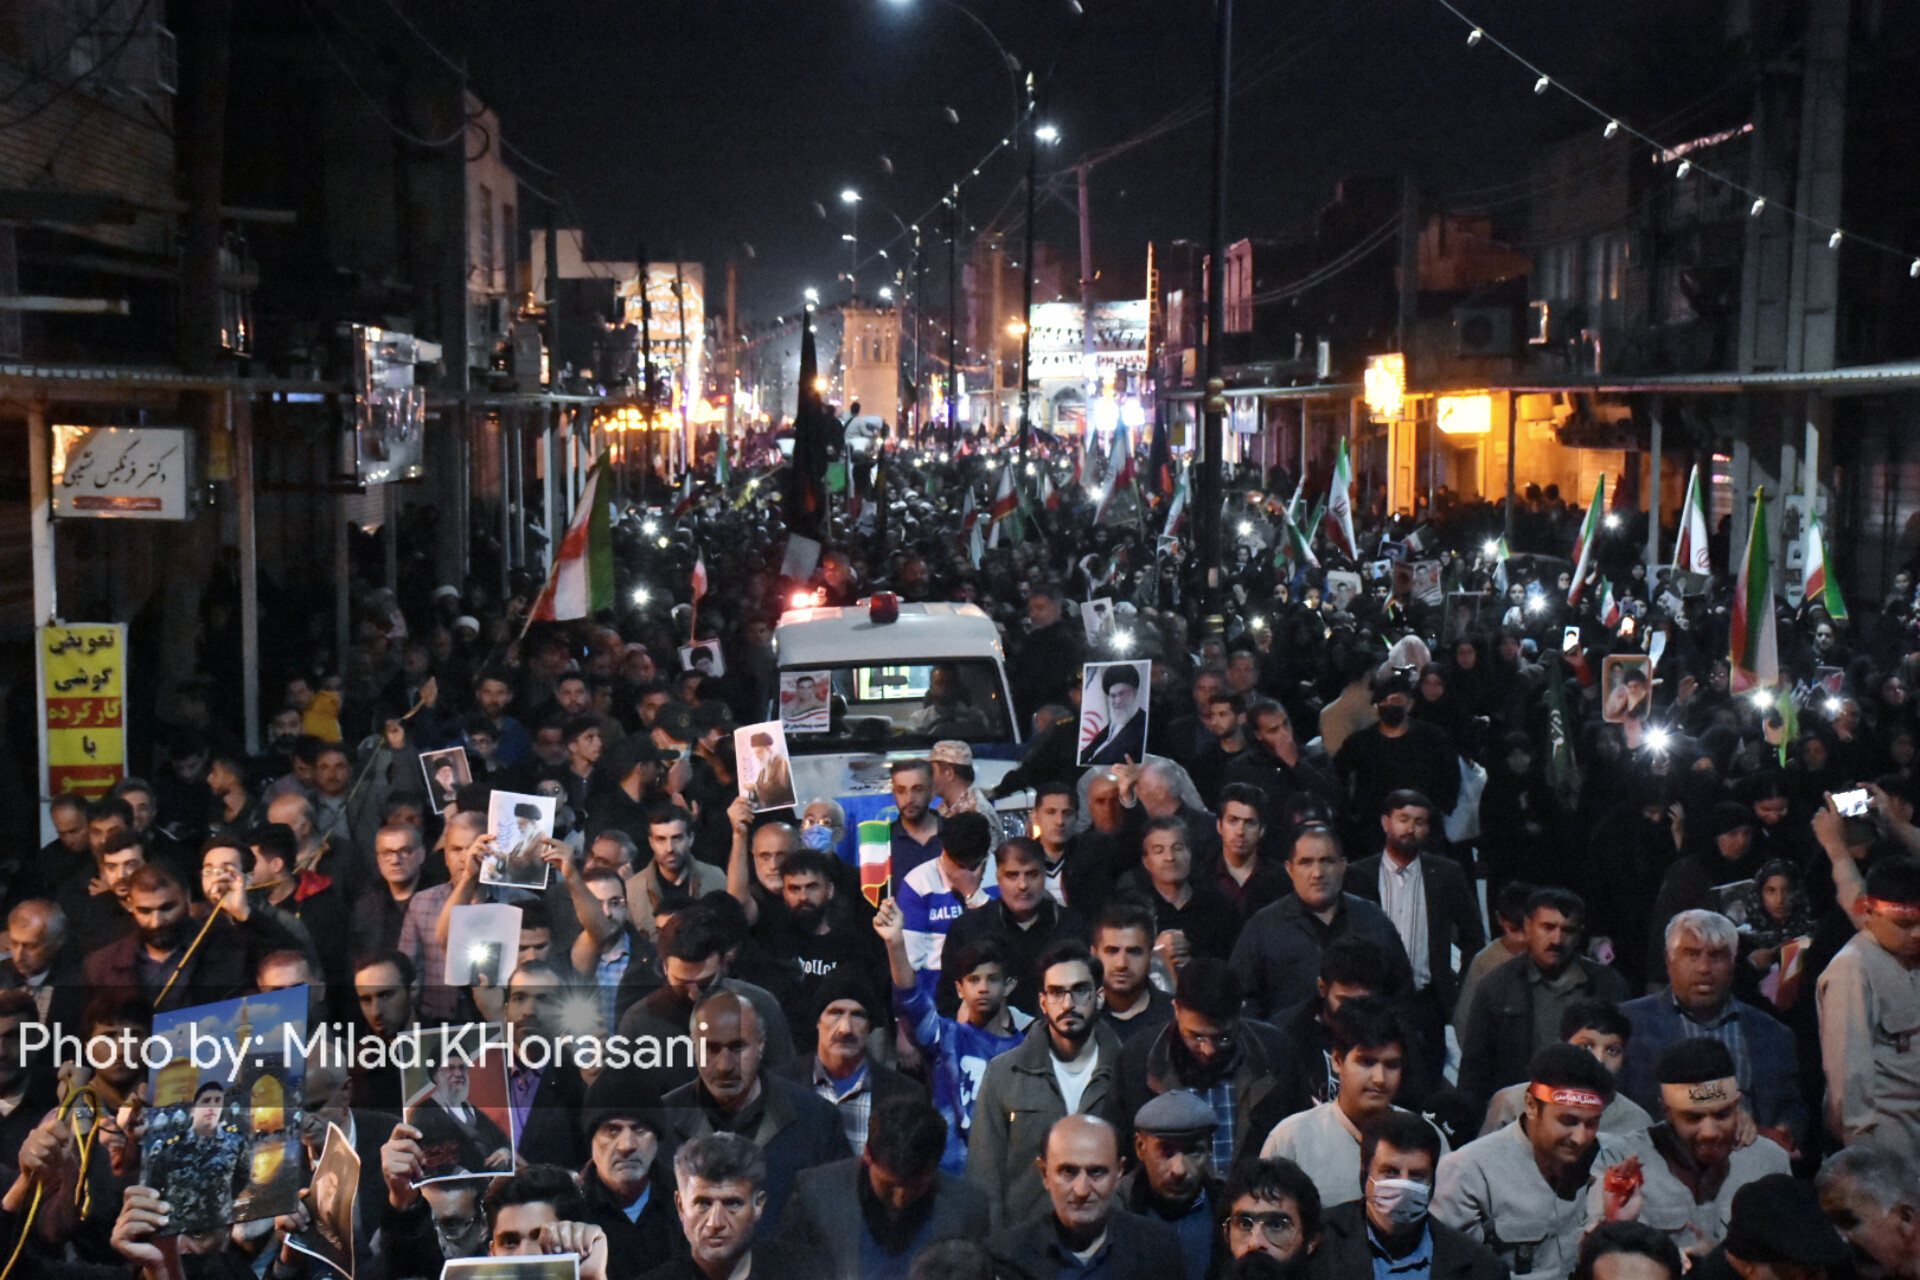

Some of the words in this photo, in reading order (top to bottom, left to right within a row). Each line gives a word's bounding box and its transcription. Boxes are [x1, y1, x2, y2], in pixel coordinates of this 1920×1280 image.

[137, 445, 178, 488] دکتر
[49, 629, 115, 655] تعویض
[54, 667, 113, 692] گوشی
[82, 735, 97, 759] با
[61, 770, 115, 794] نو
